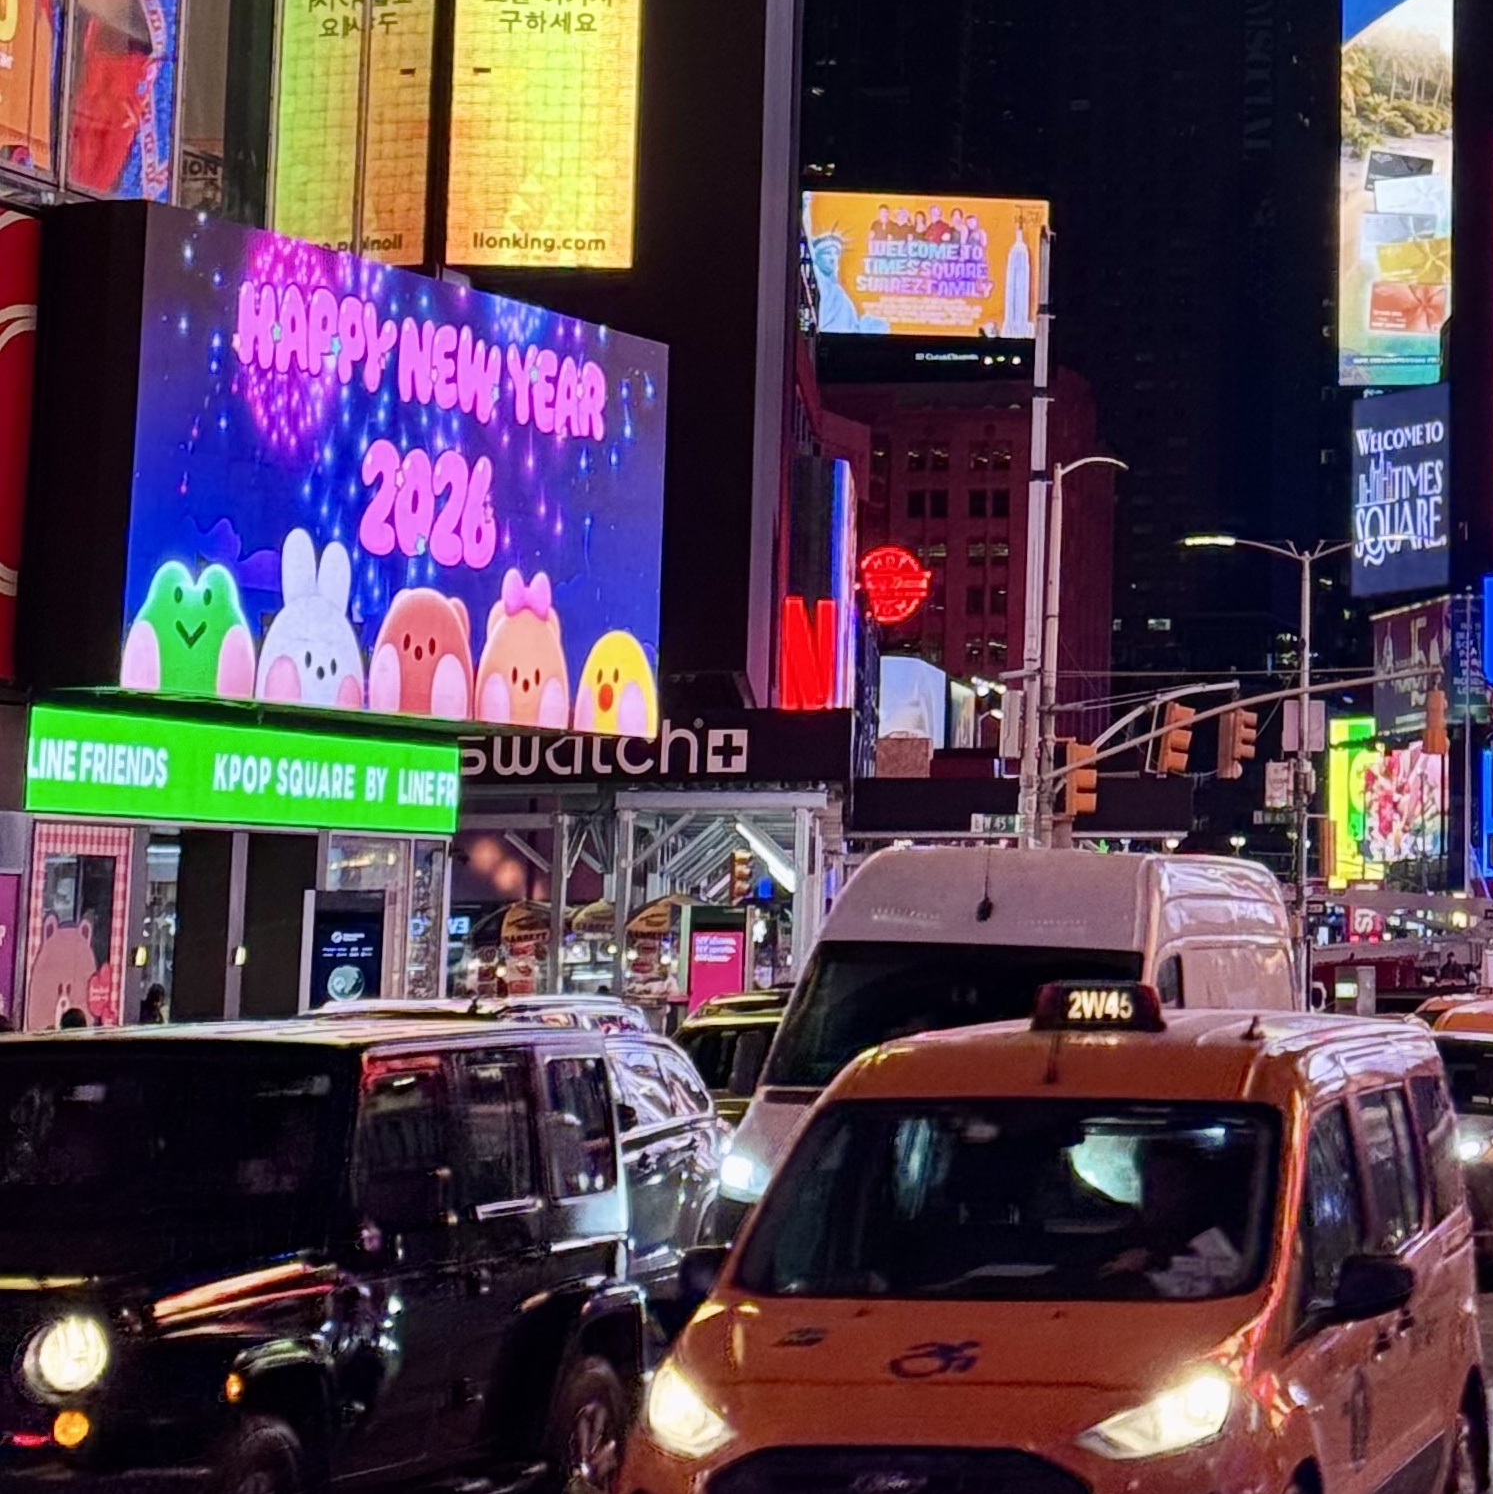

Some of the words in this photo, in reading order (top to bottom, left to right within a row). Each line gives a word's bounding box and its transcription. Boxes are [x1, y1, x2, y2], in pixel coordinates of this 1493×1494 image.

[499, 11, 598, 36] 구하세요
[472, 230, 607, 253] lionking.com
[869, 240, 960, 259] WELCOME
[960, 244, 984, 260] TO
[863, 257, 918, 276] TIMES
[918, 261, 989, 280] SQUARE
[234, 279, 398, 393] HAPPY
[398, 315, 502, 424] NEW
[507, 343, 607, 442] YEAR
[1356, 424, 1424, 456] WELCOME
[1425, 420, 1444, 444] TO
[1393, 459, 1444, 501] TIMES
[359, 438, 497, 570] 2026
[1355, 496, 1447, 568] SQUARE
[28, 737, 77, 783] LINE
[79, 740, 168, 789] FRIENDS
[457, 719, 699, 776] swatch
[213, 752, 272, 795] KPOP
[276, 757, 355, 801] SQUARE
[366, 765, 386, 800] BY
[398, 765, 436, 805] LINE
[1068, 990, 1134, 1020] 2W45
